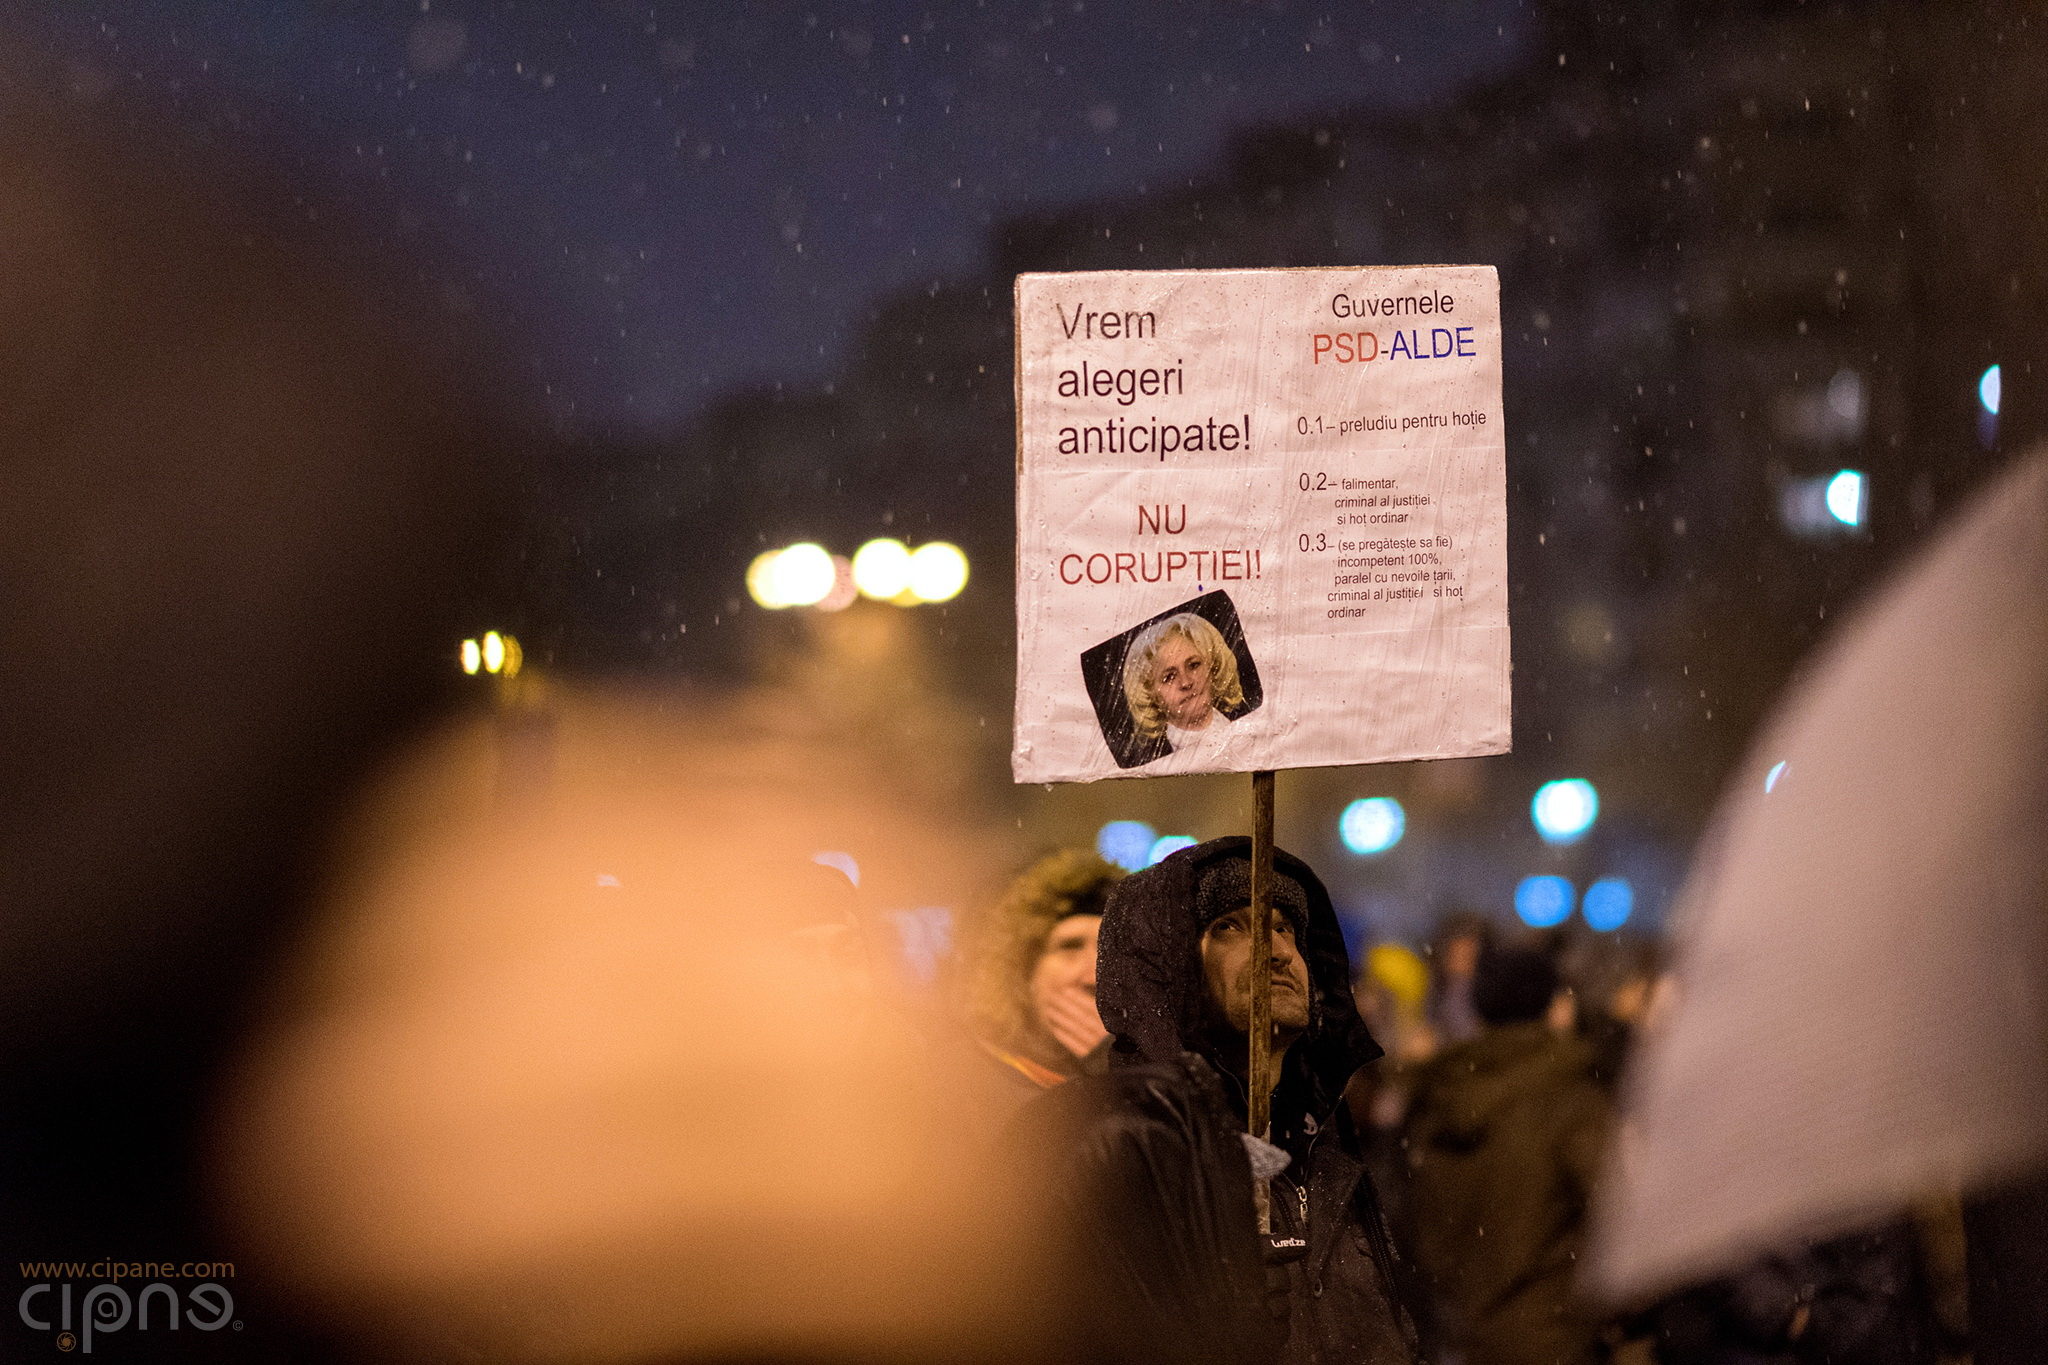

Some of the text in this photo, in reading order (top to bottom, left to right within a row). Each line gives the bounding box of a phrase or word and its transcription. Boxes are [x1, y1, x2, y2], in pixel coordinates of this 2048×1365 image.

[1332, 290, 1454, 318] Guvernele
[1056, 302, 1156, 339] Vrem
[1313, 326, 1476, 365] PSD-ALDE
[1058, 359, 1183, 406] alegeri
[1340, 415, 1397, 436] preludiu
[1402, 413, 1447, 432] pentru
[1452, 410, 1487, 430] hoție
[1058, 414, 1250, 462] anticipate!
[1341, 477, 1399, 490] falimentar,
[1334, 495, 1377, 509] criminal
[1379, 495, 1390, 507] al
[1138, 504, 1186, 535] NU
[1369, 512, 1408, 524] ordinar
[1338, 538, 1355, 553] (se
[1419, 537, 1433, 548] sa
[1435, 535, 1453, 550] fie)
[1337, 553, 1442, 569] incompetent 100%,
[1334, 571, 1371, 587] paralel
[1375, 573, 1388, 584] cu
[1391, 569, 1430, 583] nevoile
[1327, 588, 1370, 603] criminal
[1373, 588, 1384, 600] al
[1327, 606, 1366, 619] ordinar
